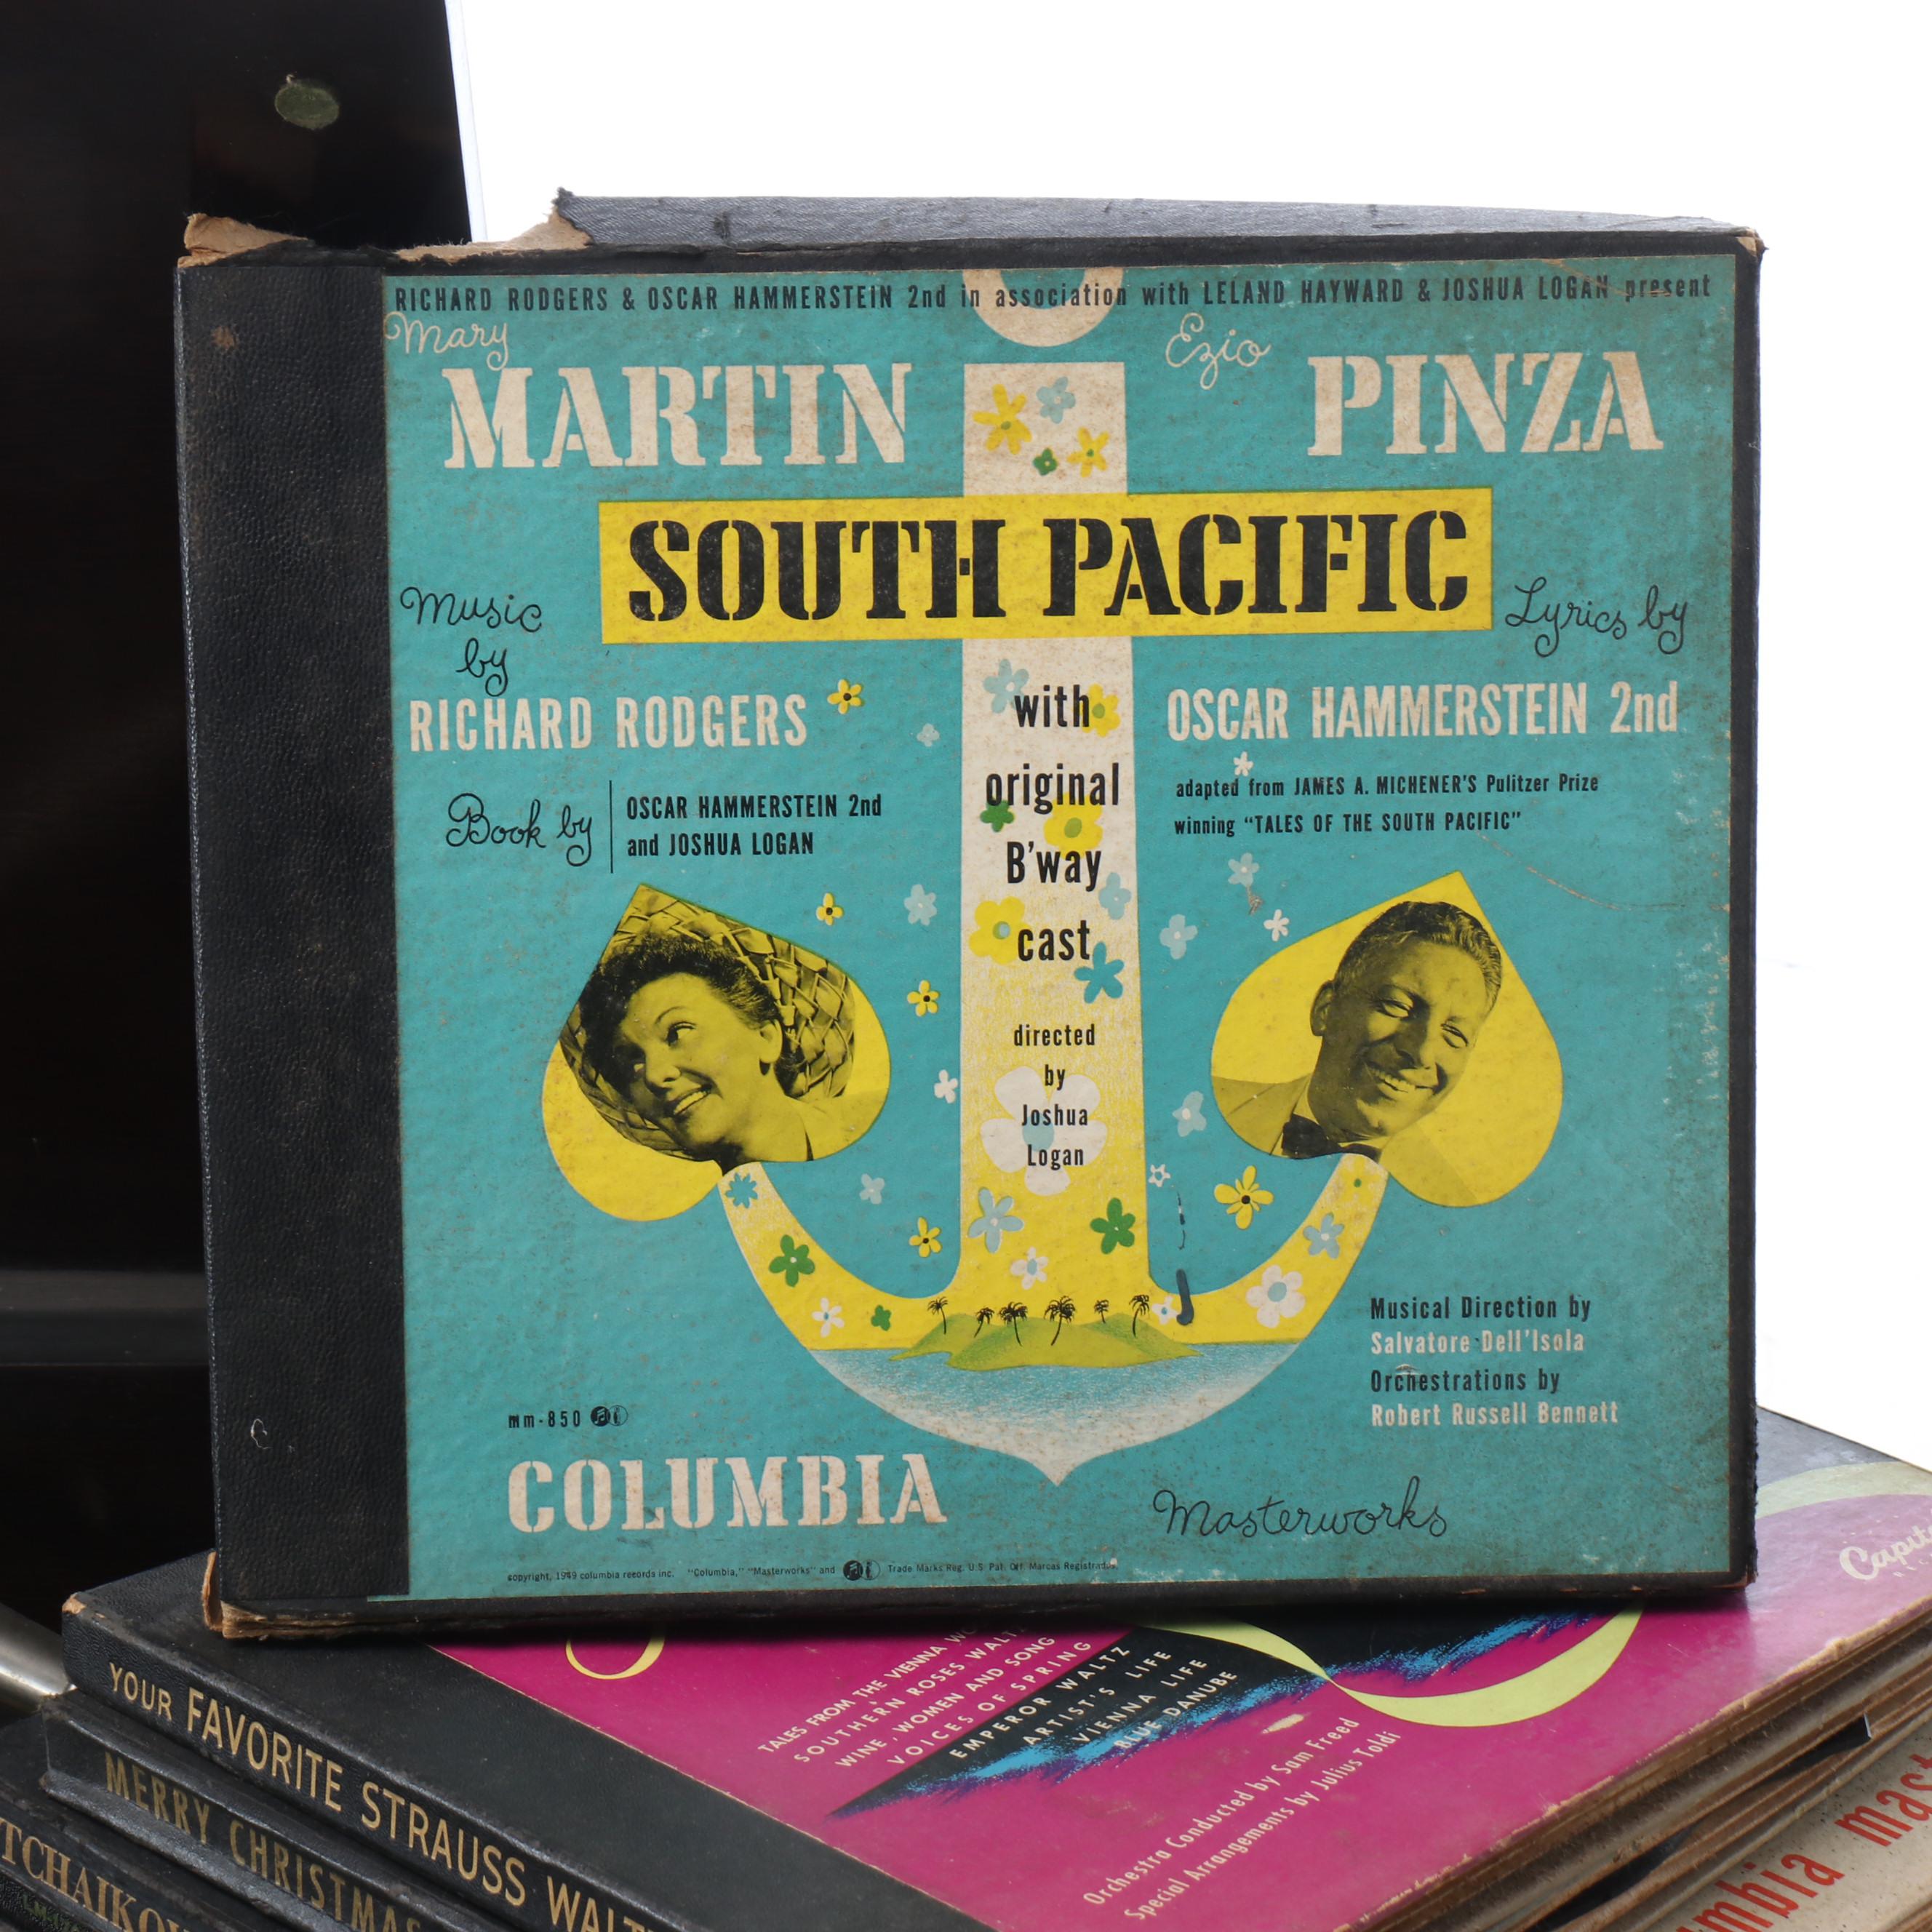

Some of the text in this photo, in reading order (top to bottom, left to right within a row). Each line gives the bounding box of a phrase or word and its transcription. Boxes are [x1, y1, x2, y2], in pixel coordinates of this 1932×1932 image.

[396, 274, 1711, 311] RICHARD RODGERS & OSCAR HAMMERSTEIN 2nd in association with LELAND HAYWARD & JOSHUA LOGAN present
[384, 311, 508, 371] Mary
[1165, 312, 1272, 390] Ezio
[442, 363, 912, 468] MARTIN
[1307, 351, 1664, 456] PINZA
[628, 510, 1469, 622] SOUTH PACIFIC
[400, 586, 543, 632] Music
[1504, 576, 1689, 658] Lyrics by
[456, 638, 509, 697] by
[409, 694, 807, 752] RICHARD RODGERS
[1014, 684, 1090, 727] with
[1167, 680, 1678, 741] OSCAR HAMMERSTEIN 2nd
[626, 793, 882, 821] OSCAR HAMMERSTEIN 2nd
[986, 762, 1119, 815] original
[1175, 772, 1599, 801] adapted from JAMES A. MICHENER'S Pulitzer Prize
[446, 793, 593, 866] Book by
[627, 832, 814, 857] and JOSHUA LOGAN
[1174, 816, 1235, 839] winning
[1314, 814, 1335, 833] OF
[1342, 813, 1372, 832] THE
[1381, 813, 1435, 831] SOUTH
[1007, 841, 1102, 892] B'way
[1017, 919, 1091, 962] cast
[1013, 1024, 1095, 1046] directed
[1044, 1064, 1066, 1090] by
[1021, 1103, 1088, 1127] Joshua
[1026, 1143, 1084, 1170] Logan
[1370, 1293, 1592, 1322] Musical Direction by
[1371, 1328, 1584, 1354] Salvatore Dell'Isola
[1370, 1368, 1560, 1394] Orchestrations by
[1371, 1401, 1619, 1427] Robert Russell Bennett
[508, 1453, 947, 1533] COLUMBIA
[1153, 1475, 1448, 1538] Masterworks
[508, 1572, 552, 1582] copyright,
[556, 1570, 578, 1581] 1949
[580, 1569, 620, 1580] columbia
[623, 1568, 655, 1579] records
[658, 1568, 675, 1578] inc.
[820, 1565, 835, 1574] and
[888, 1564, 911, 1573] Trade
[917, 1563, 943, 1573] Marks
[1029, 1562, 1061, 1571] Marcas
[1839, 1525, 1932, 1580] Capit
[758, 1726, 807, 1752] TALES
[805, 1699, 856, 1726] FROM
[852, 1680, 887, 1698] THE
[884, 1645, 947, 1679] VIENNA
[794, 1698, 906, 1763] SOUTHERN
[906, 1662, 965, 1696] ROSES
[887, 1642, 1091, 1765] VOICES OF SPRING
[892, 1693, 965, 1733] WOMEN
[965, 1668, 1004, 1692] AND
[1005, 1637, 1055, 1666] SONG
[949, 1646, 1130, 1758] EMPEROR WALTZ
[1023, 1650, 1172, 1746] ARTIST'S LIFE
[1072, 1659, 1208, 1743] VIENNA LIFE
[1114, 1672, 1237, 1749] BLUE DANUBE
[105, 1752, 209, 1845] MERRY
[109, 1661, 172, 1721] YOUR
[187, 1687, 343, 1812] FAVORITE
[362, 1781, 526, 1907] STRAUSS
[1084, 1716, 1360, 1906] Orchestra Conducted by Sam Freed
[1124, 1731, 1401, 1920] Special Arrangements by Julius Toldi
[0, 1817, 188, 1932] TCHAIKO
[1673, 1853, 1845, 1932] mbia
